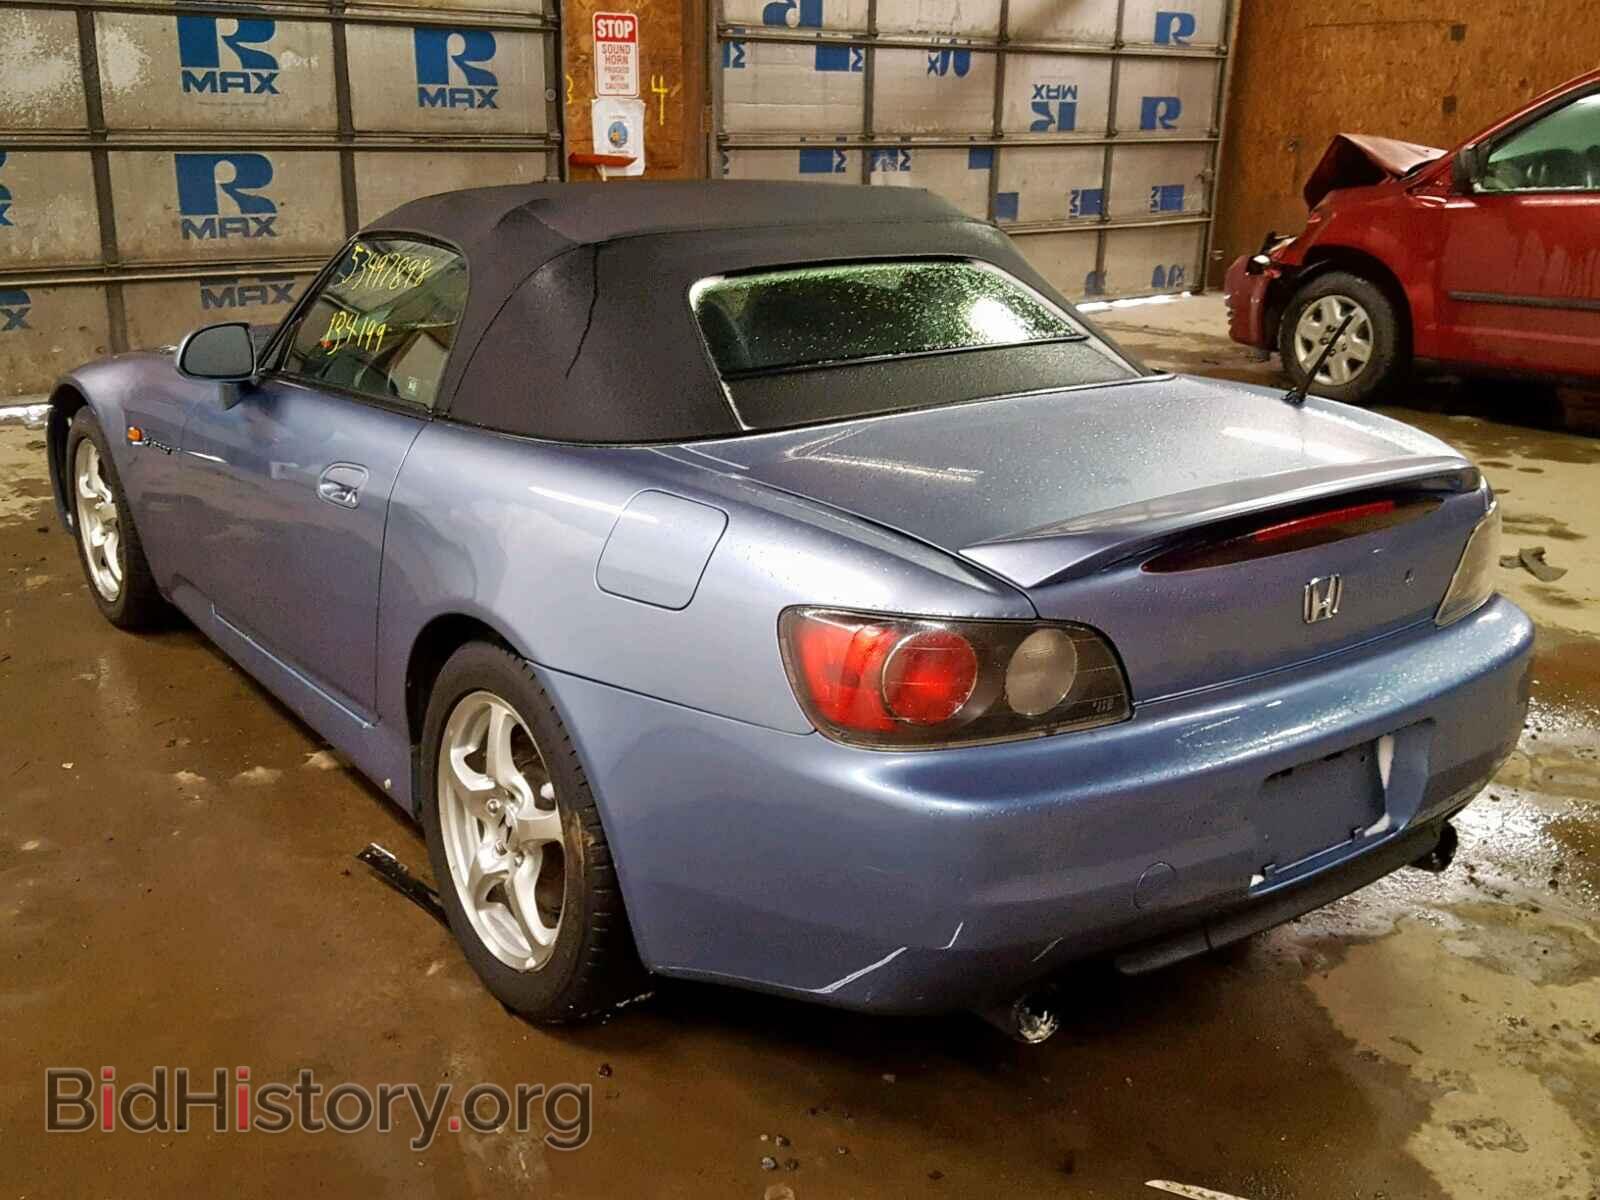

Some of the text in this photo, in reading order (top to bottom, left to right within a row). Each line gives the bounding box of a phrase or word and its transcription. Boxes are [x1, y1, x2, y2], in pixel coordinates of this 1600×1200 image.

[596, 19, 634, 38] STOP
[1154, 12, 1196, 46] R
[176, 16, 279, 70] R
[601, 44, 631, 54] SOUND
[415, 29, 498, 86] R
[605, 55, 629, 65] HORN
[181, 70, 280, 94] MAX
[1032, 84, 1078, 100] MAX
[418, 87, 499, 109] MAX
[651, 74, 669, 126] 4
[1140, 96, 1183, 130] R
[175, 153, 278, 215] R
[180, 216, 278, 240] MAX
[201, 284, 296, 310] MAX
